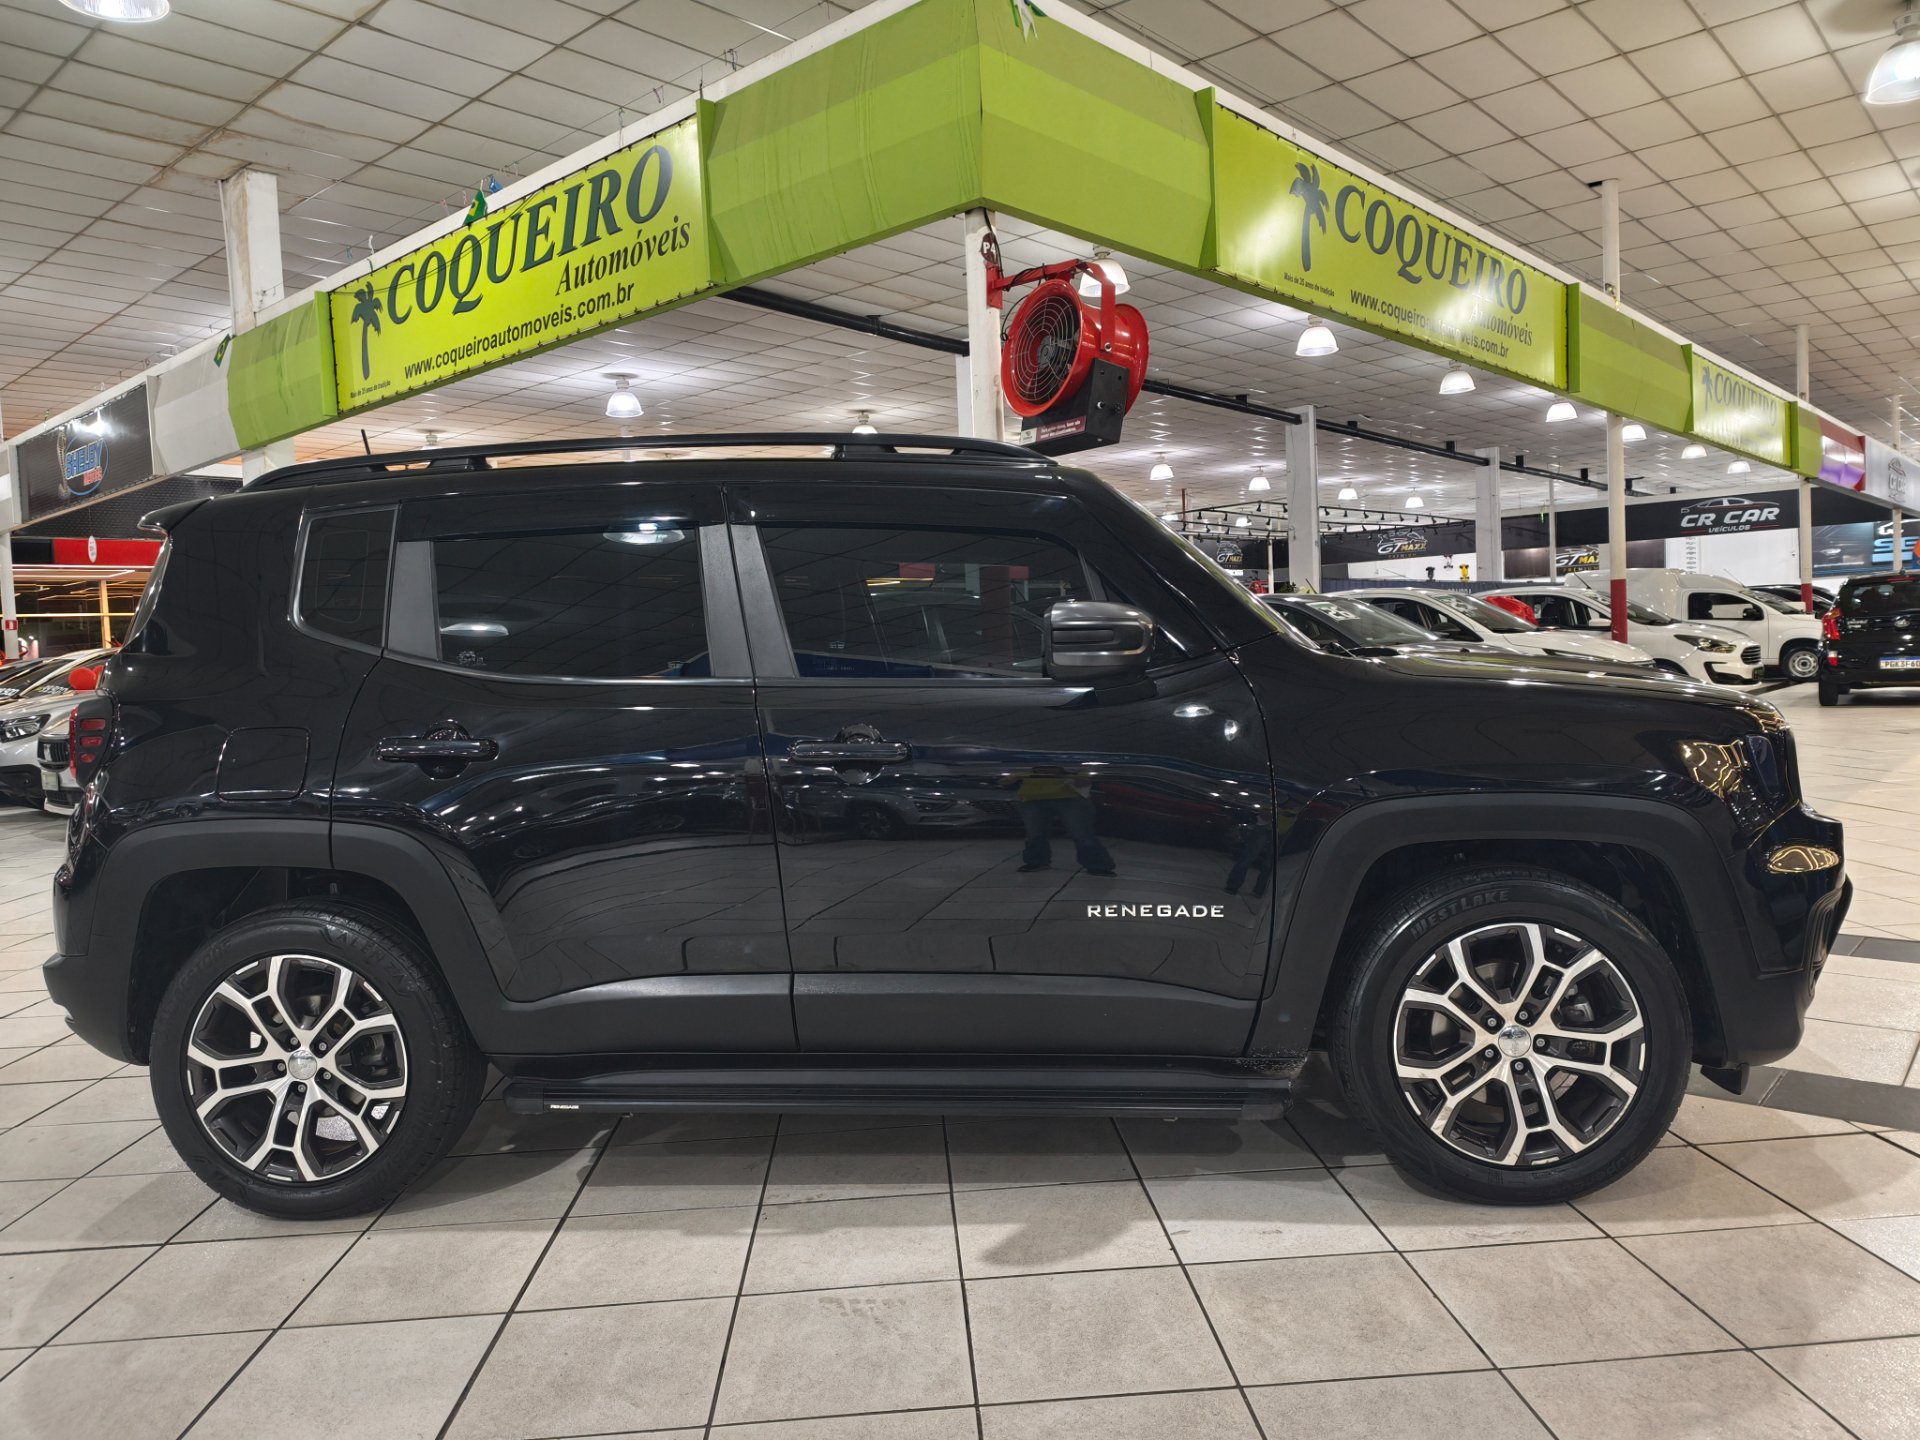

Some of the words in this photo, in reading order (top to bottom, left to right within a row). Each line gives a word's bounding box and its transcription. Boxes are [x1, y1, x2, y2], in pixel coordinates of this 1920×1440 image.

[387, 144, 674, 325] COQUEIRO
[555, 215, 690, 296] Automóveis
[1334, 184, 1527, 315] COQUEIRO
[404, 282, 635, 379] www.coqueiroautomoveis.com.br
[65, 438, 103, 480] SHELBY
[1681, 513, 1716, 527] CR
[1723, 507, 1780, 524] CAR
[1087, 904, 1225, 918] RENEGADE
